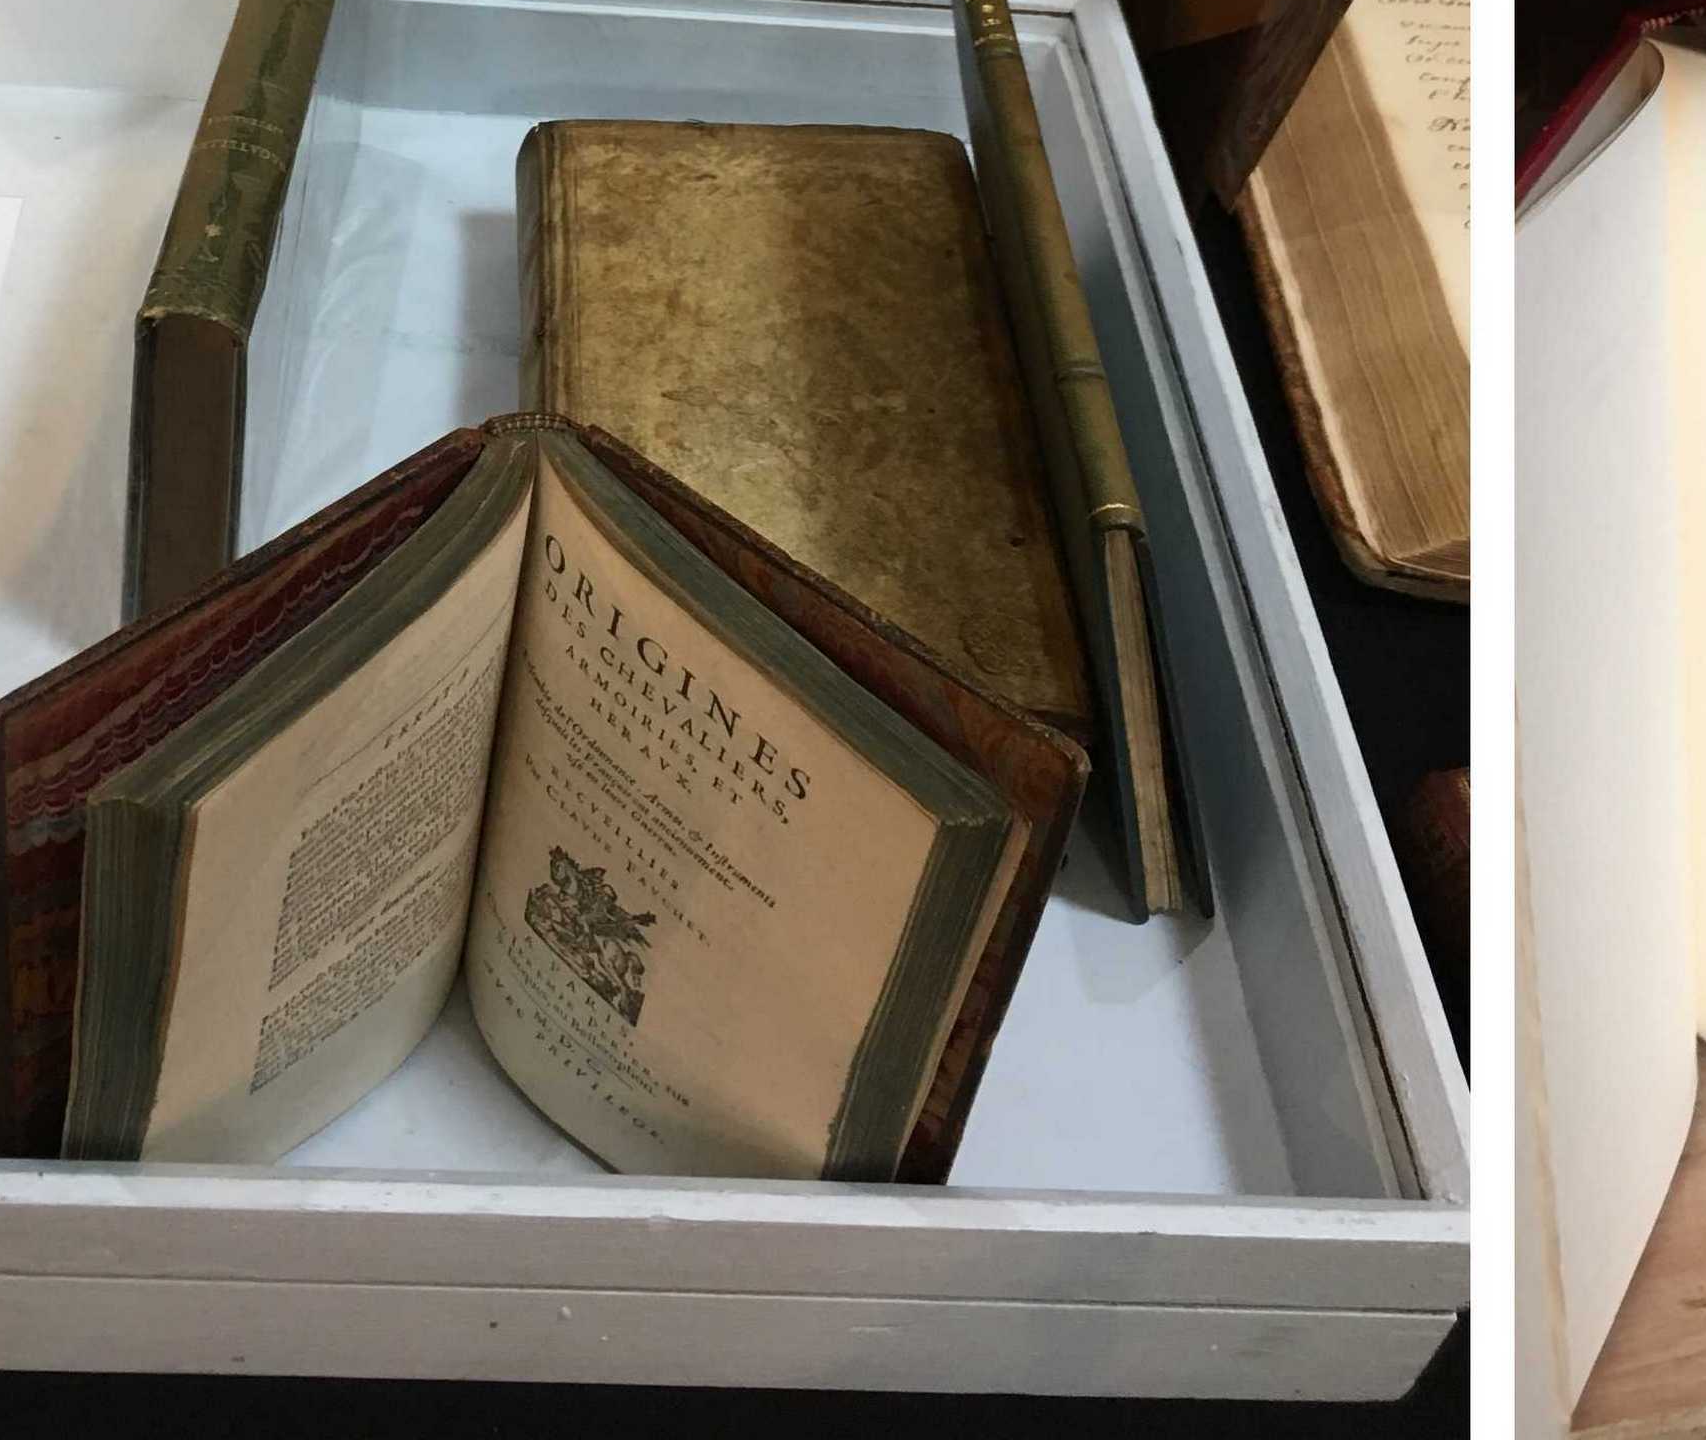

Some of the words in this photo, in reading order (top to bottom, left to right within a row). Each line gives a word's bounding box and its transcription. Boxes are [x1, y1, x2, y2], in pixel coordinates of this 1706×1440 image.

[544, 580, 586, 639] DES
[599, 646, 789, 825] CHEVALIERS,
[545, 534, 811, 801] ORIGINES
[565, 644, 697, 774] ARMOIRIES,
[712, 776, 743, 805] ET
